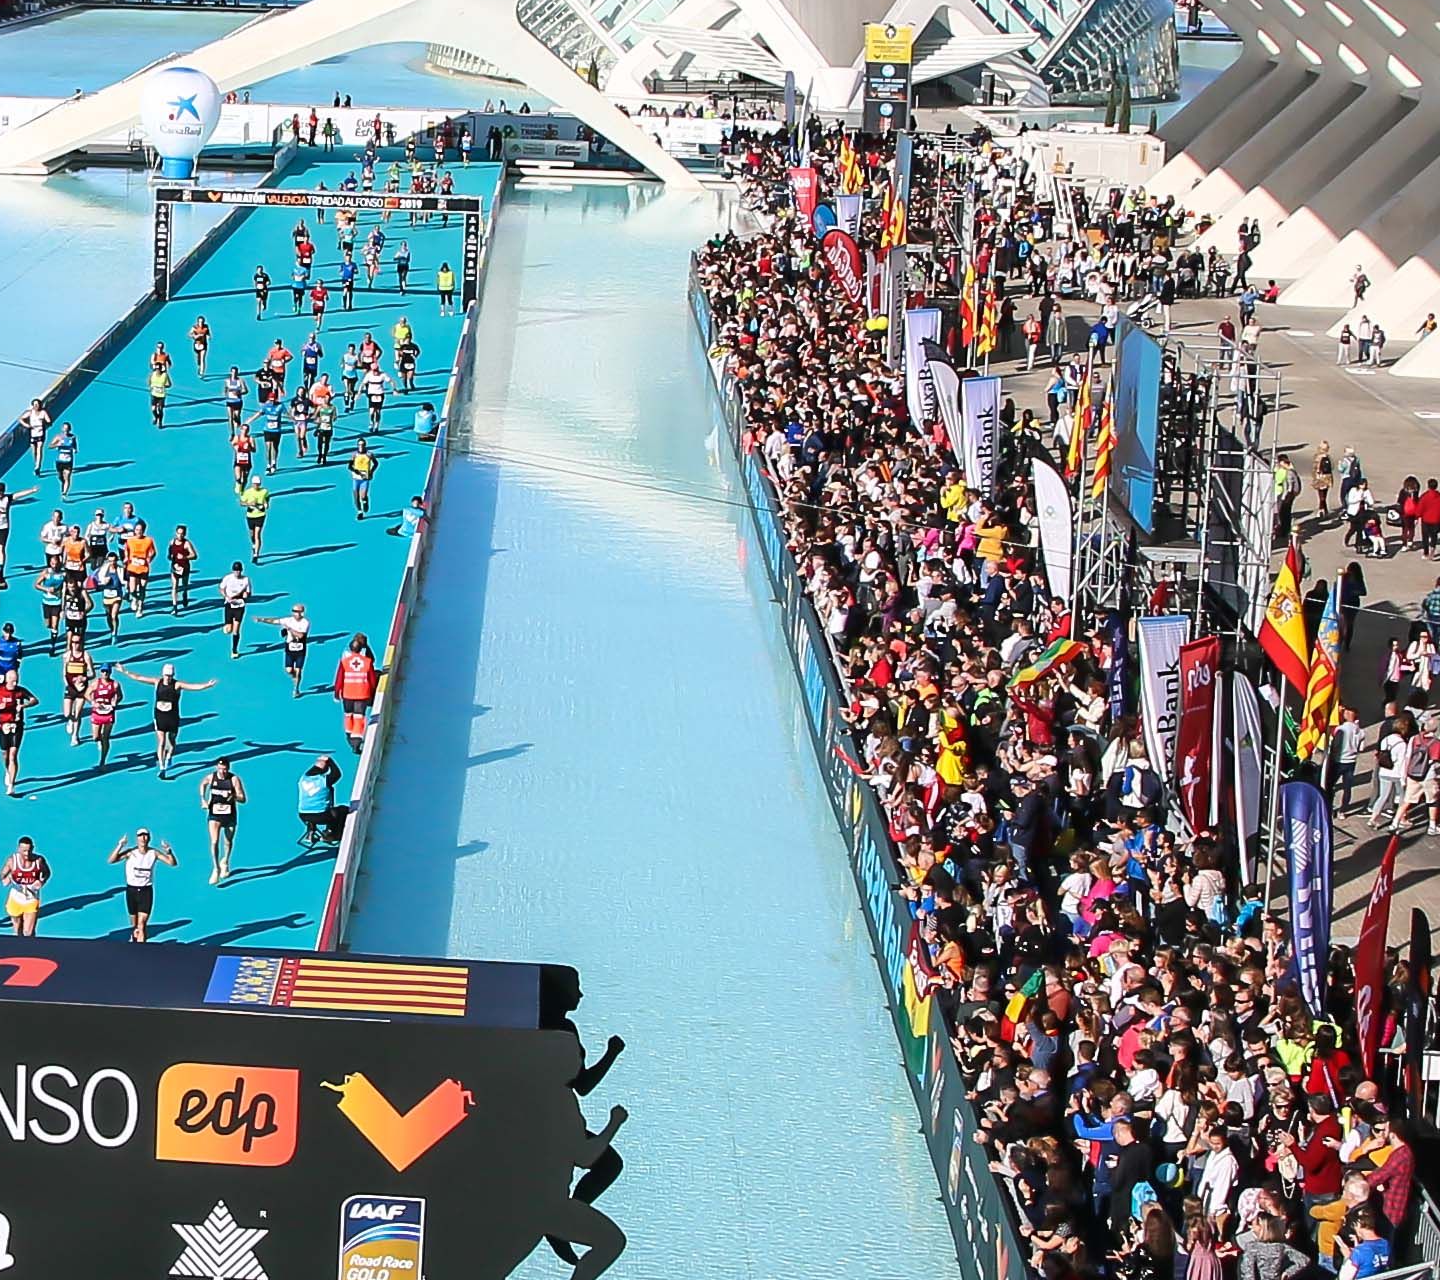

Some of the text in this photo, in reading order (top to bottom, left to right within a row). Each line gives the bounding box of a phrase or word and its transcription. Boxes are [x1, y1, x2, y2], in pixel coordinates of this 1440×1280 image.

[174, 1077, 278, 1153] edp
[349, 1200, 407, 1221] IAAF
[348, 1254, 414, 1270] Road Race
